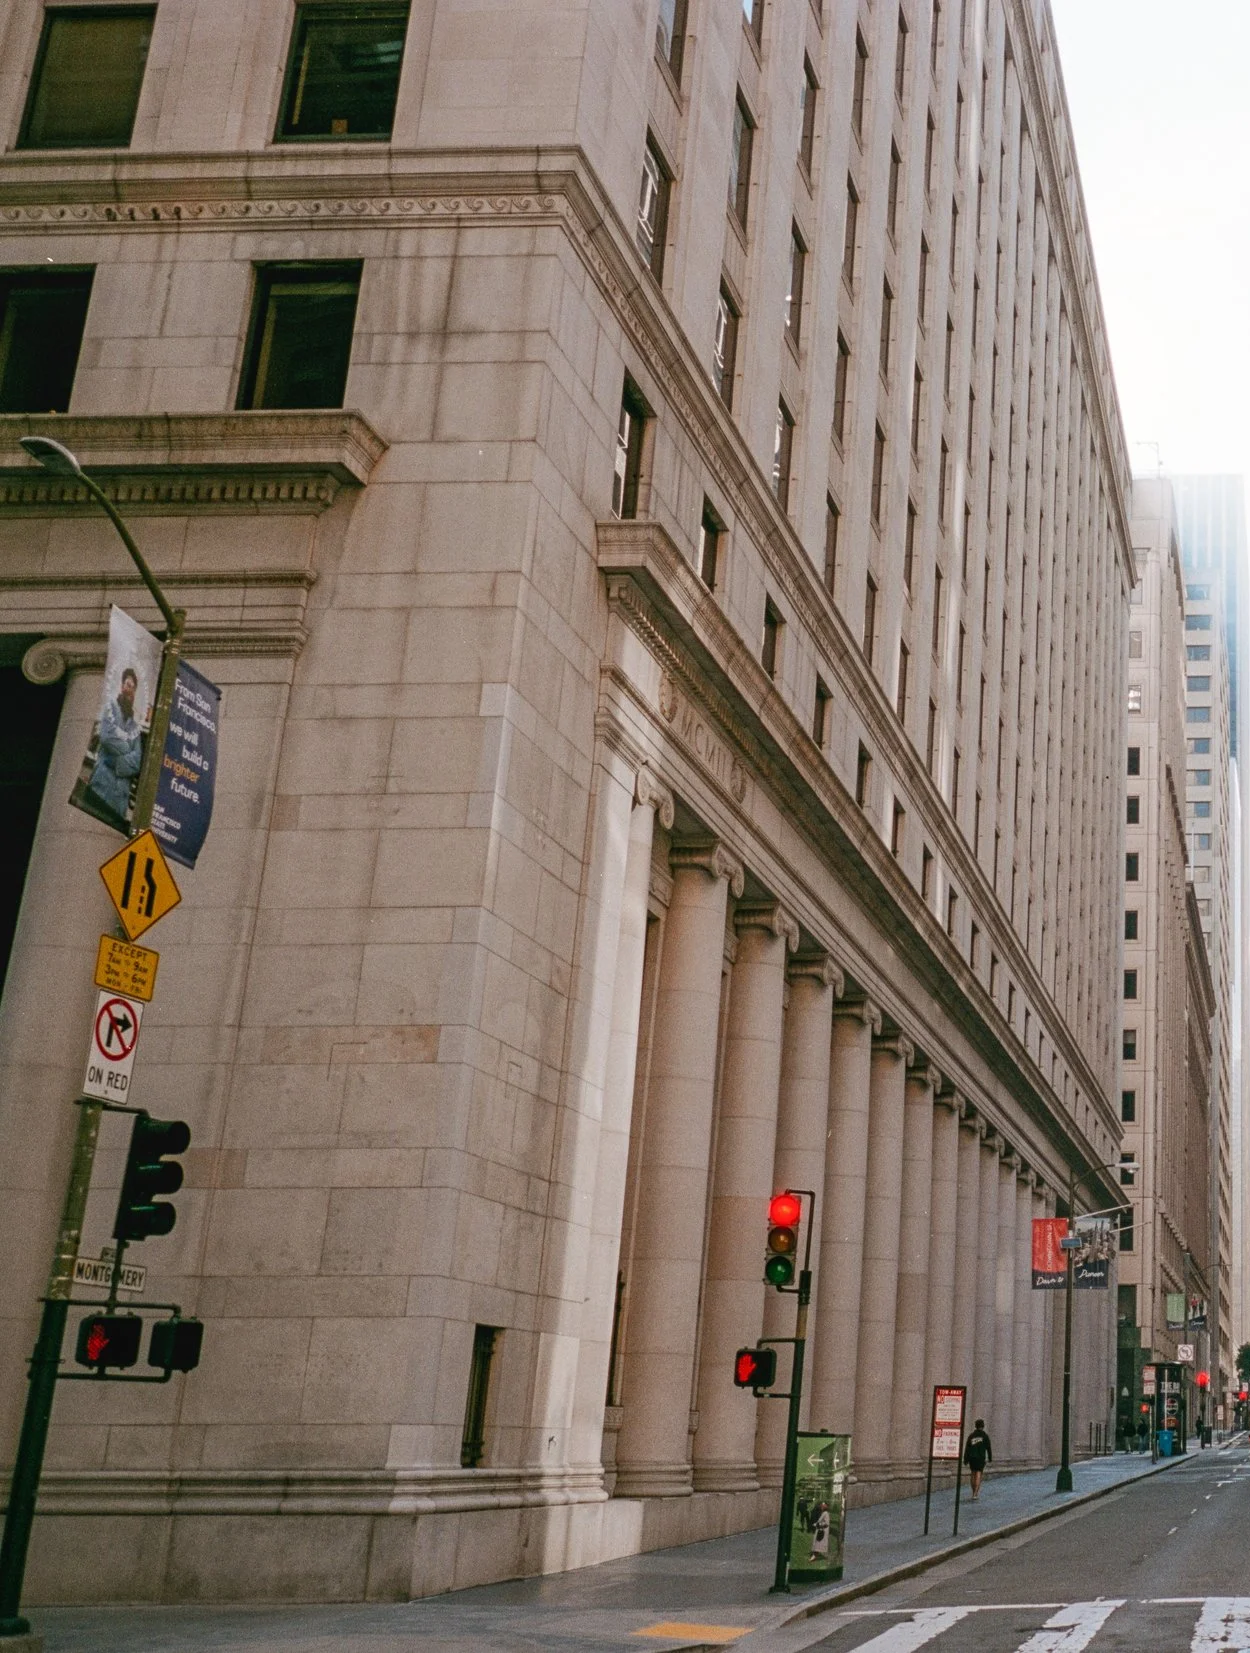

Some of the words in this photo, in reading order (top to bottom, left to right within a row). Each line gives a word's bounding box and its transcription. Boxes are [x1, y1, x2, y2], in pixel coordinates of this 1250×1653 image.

[175, 678, 197, 703] From
[195, 693, 212, 713] San
[170, 724, 184, 738] we
[183, 730, 199, 747] will
[163, 754, 200, 783] brighter
[182, 745, 203, 767] build
[171, 779, 200, 805] future.
[112, 942, 148, 962] EXCEPT
[88, 1066, 103, 1083] ON
[107, 1073, 128, 1091] RED
[75, 1262, 145, 1287] MONTGMERY
